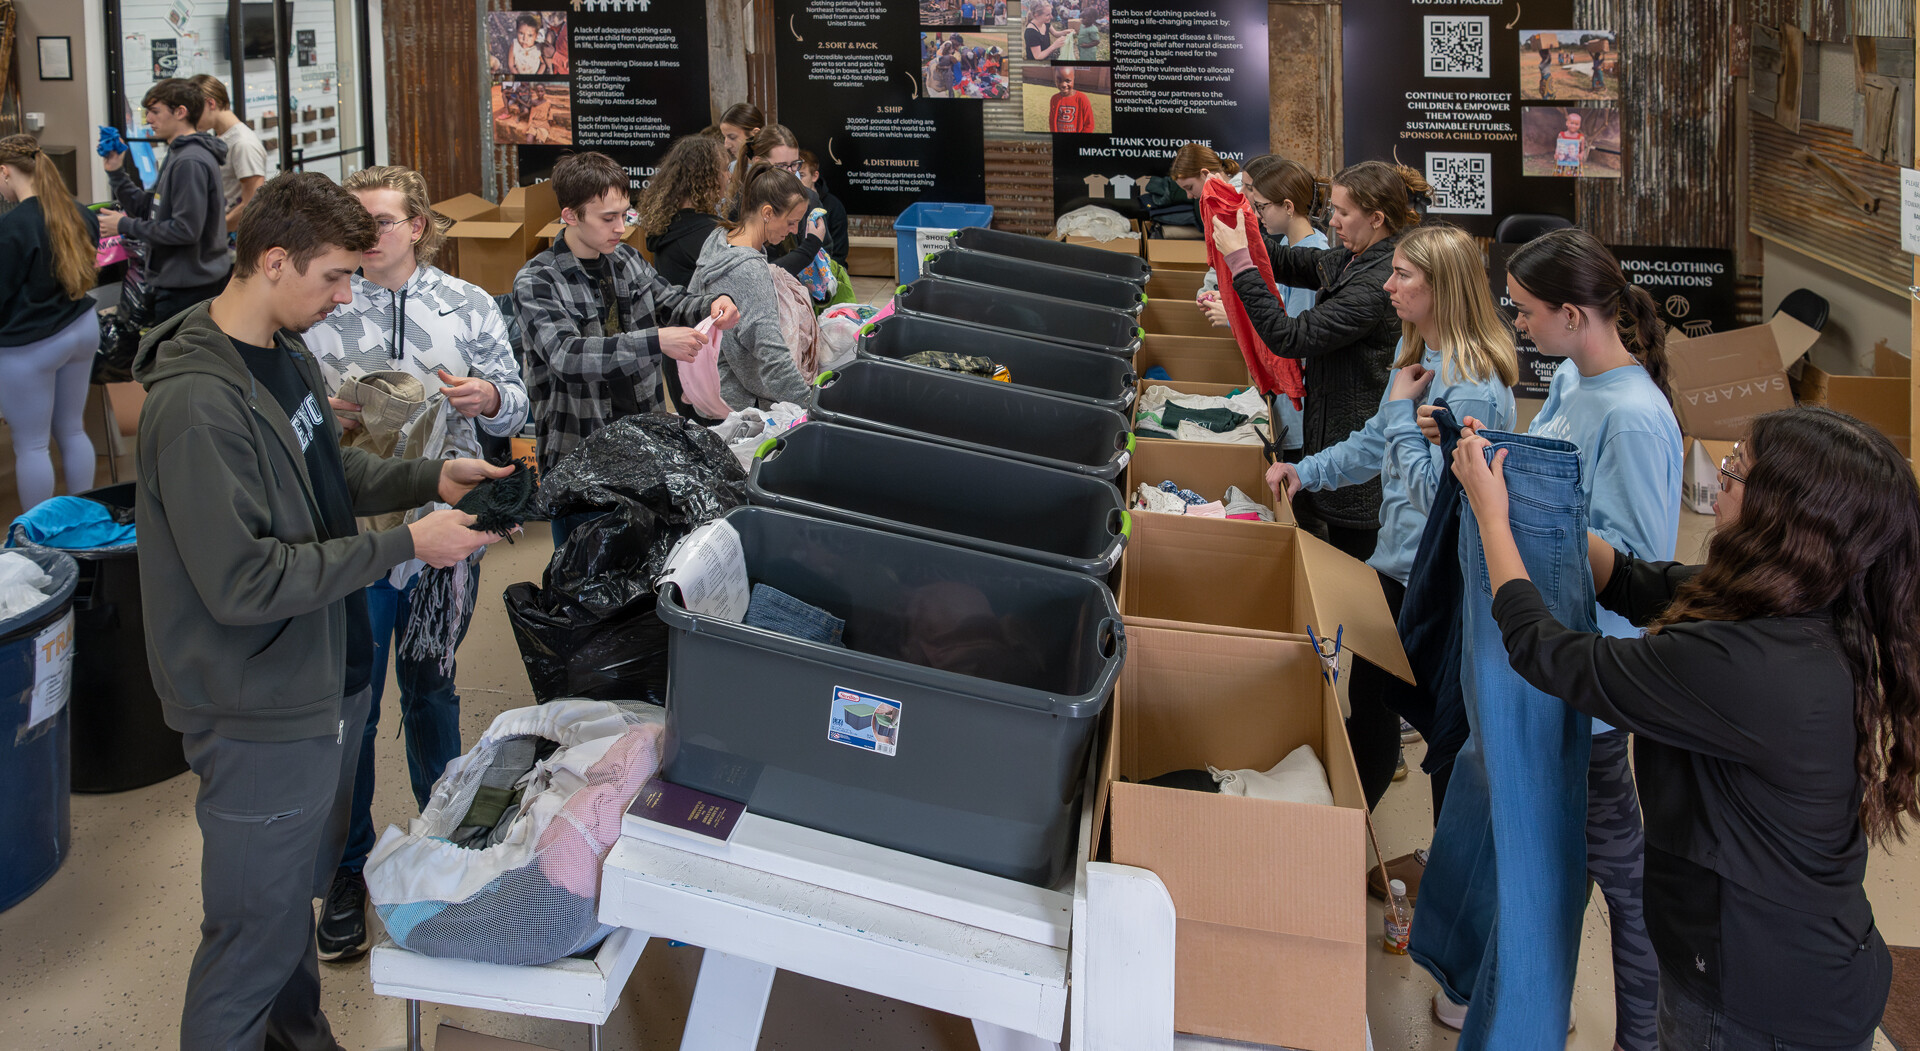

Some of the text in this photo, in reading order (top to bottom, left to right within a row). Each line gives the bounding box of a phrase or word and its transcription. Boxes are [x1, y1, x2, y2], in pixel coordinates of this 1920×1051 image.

[1153, 10, 1182, 18] clothing
[1112, 18, 1139, 26] making
[1146, 18, 1192, 26] life-changing
[1220, 19, 1231, 27] by:
[601, 27, 631, 35] adequate
[632, 27, 658, 35] clothing
[1213, 34, 1236, 42] illness
[1406, 92, 1453, 100] CONTINUE
[1470, 93, 1511, 101] PROTECT
[1155, 98, 1188, 106] providing
[1190, 99, 1238, 107] opportunities
[1408, 102, 1453, 110] CHILDREN
[1464, 103, 1510, 111] EMPOWER
[1426, 112, 1451, 120] THEM
[1407, 122, 1512, 131] SUSTAINABLE FUTURES.
[1484, 133, 1517, 141] TODAY!
[1110, 138, 1144, 146] THANK
[1146, 139, 1168, 147] YOU
[1080, 148, 1117, 157] IMPACT
[1118, 149, 1140, 157] YOU
[1142, 150, 1161, 158] ARE
[1216, 151, 1244, 160] ODAY!
[871, 159, 919, 167] DISTRIBUTE
[622, 167, 661, 176] CHILDR
[1620, 260, 1724, 275] NON-CLOTHING
[1633, 274, 1712, 287] DONATIONS
[1531, 362, 1559, 370] FORGO
[1685, 377, 1785, 406] SAKARA
[42, 623, 73, 664] TRA
